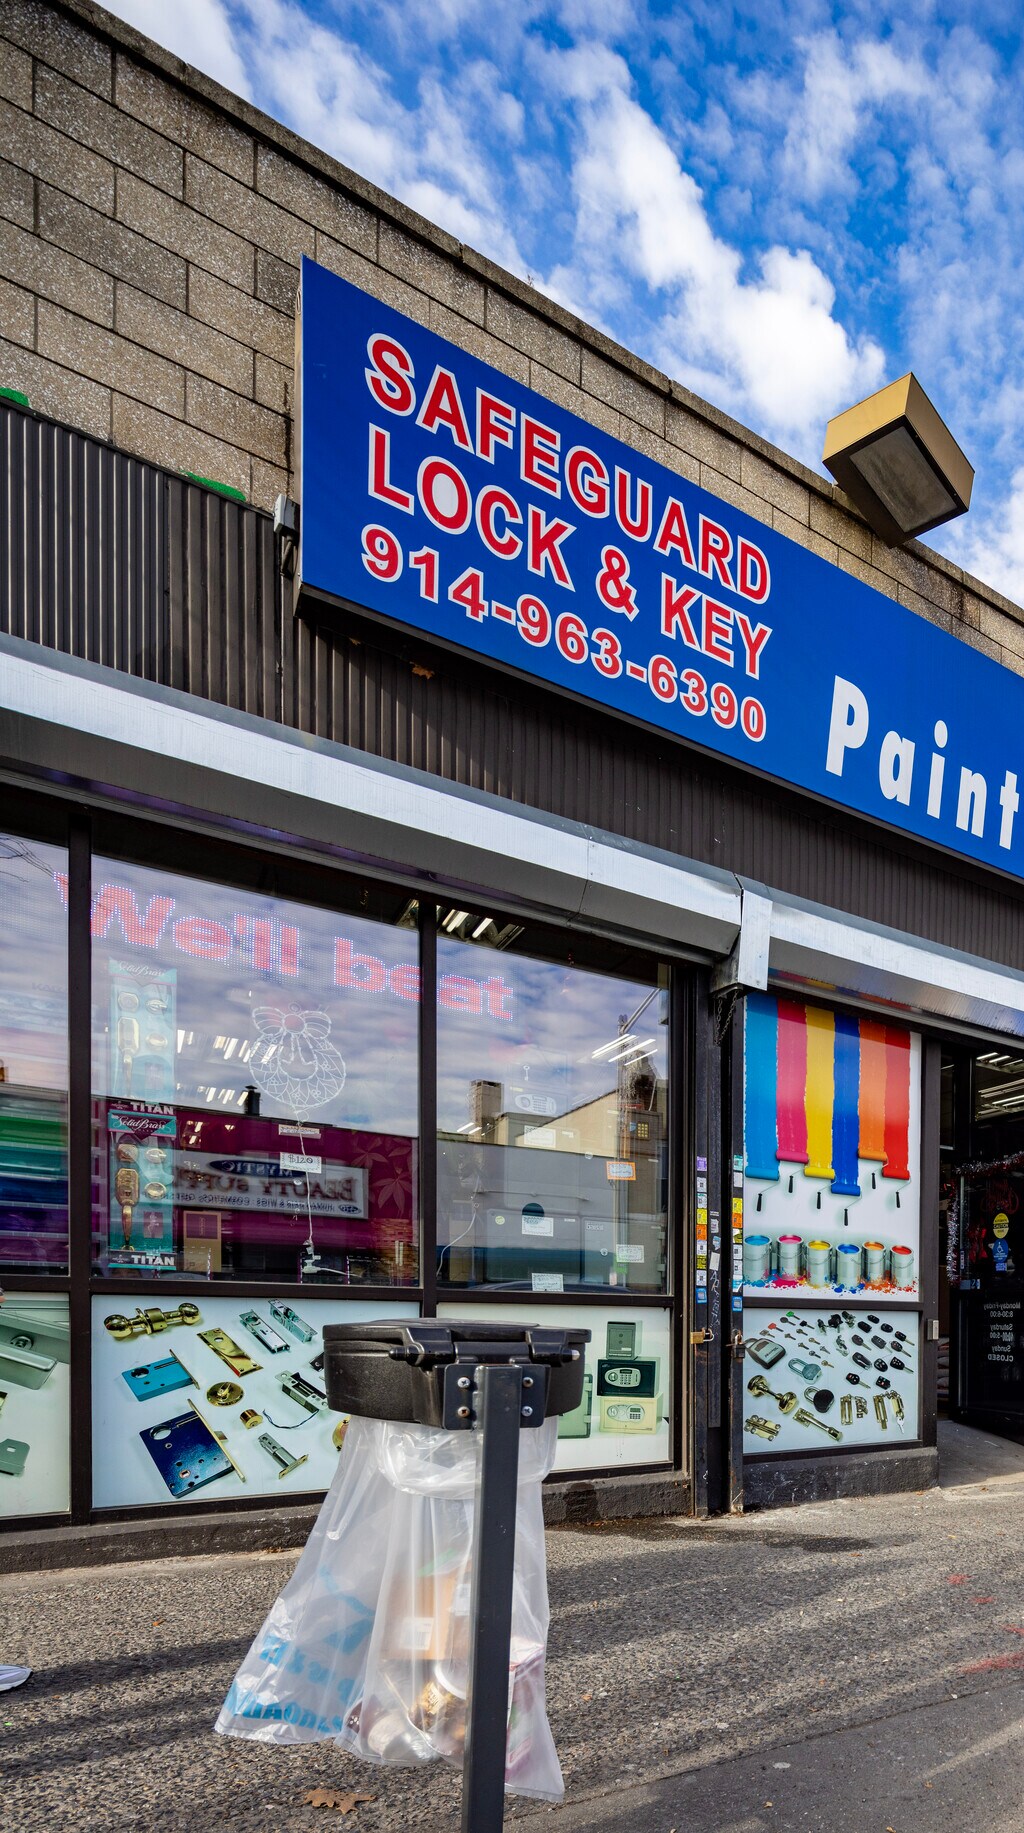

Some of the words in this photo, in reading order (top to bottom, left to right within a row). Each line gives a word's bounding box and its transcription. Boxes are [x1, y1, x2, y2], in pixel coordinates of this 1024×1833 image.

[364, 333, 772, 605] SAFEGUARD
[368, 423, 576, 592] LOCK
[596, 545, 640, 621] &
[661, 572, 773, 681] KEY
[361, 523, 767, 743] 914-963-6390
[825, 675, 1020, 850] Paint
[54, 871, 300, 977] We'll
[334, 936, 513, 1021] beat
[114, 1113, 141, 1130] Solid
[130, 1102, 174, 1115] TITAN
[288, 1154, 314, 1165] $120
[131, 1254, 175, 1266] TITAN
